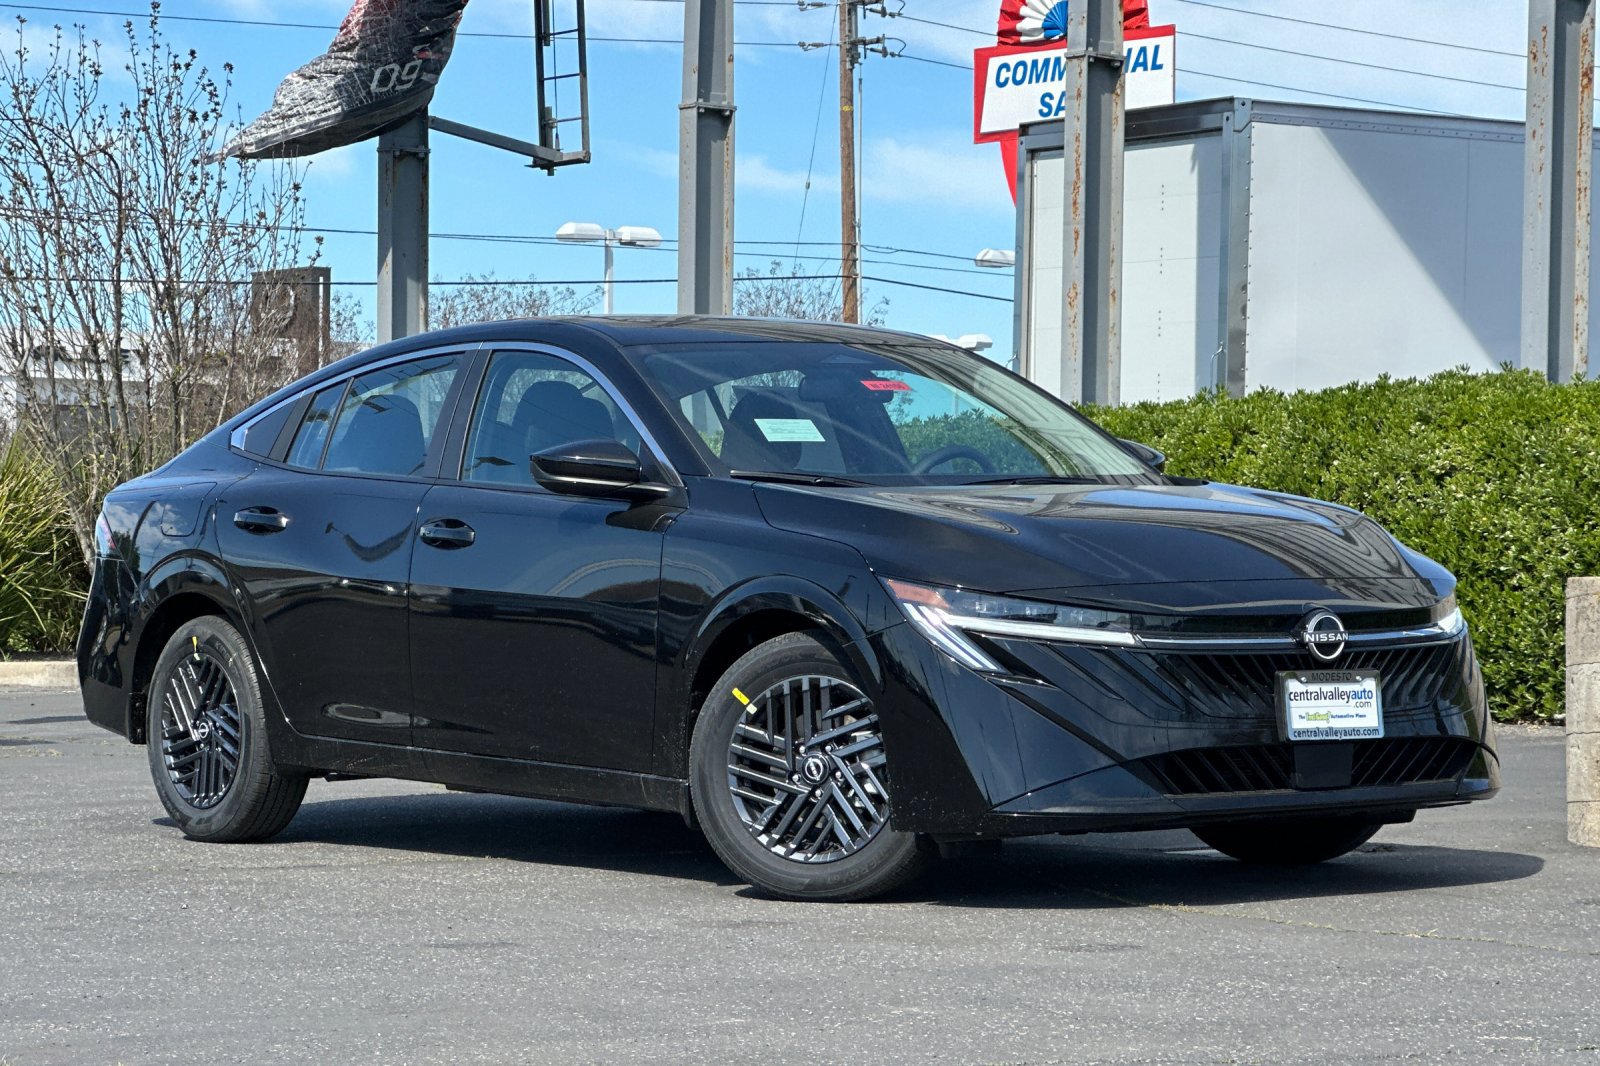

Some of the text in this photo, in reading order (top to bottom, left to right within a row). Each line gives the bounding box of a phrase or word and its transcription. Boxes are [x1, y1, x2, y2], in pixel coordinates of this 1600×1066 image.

[995, 44, 1164, 89] COMMIAL
[1038, 92, 1067, 118] SA
[1306, 633, 1349, 642] NISSAN
[1312, 673, 1352, 682] MODESTO
[1289, 687, 1373, 703] centralvalleyauto
[1293, 727, 1379, 739] centralvalleyauto.com
